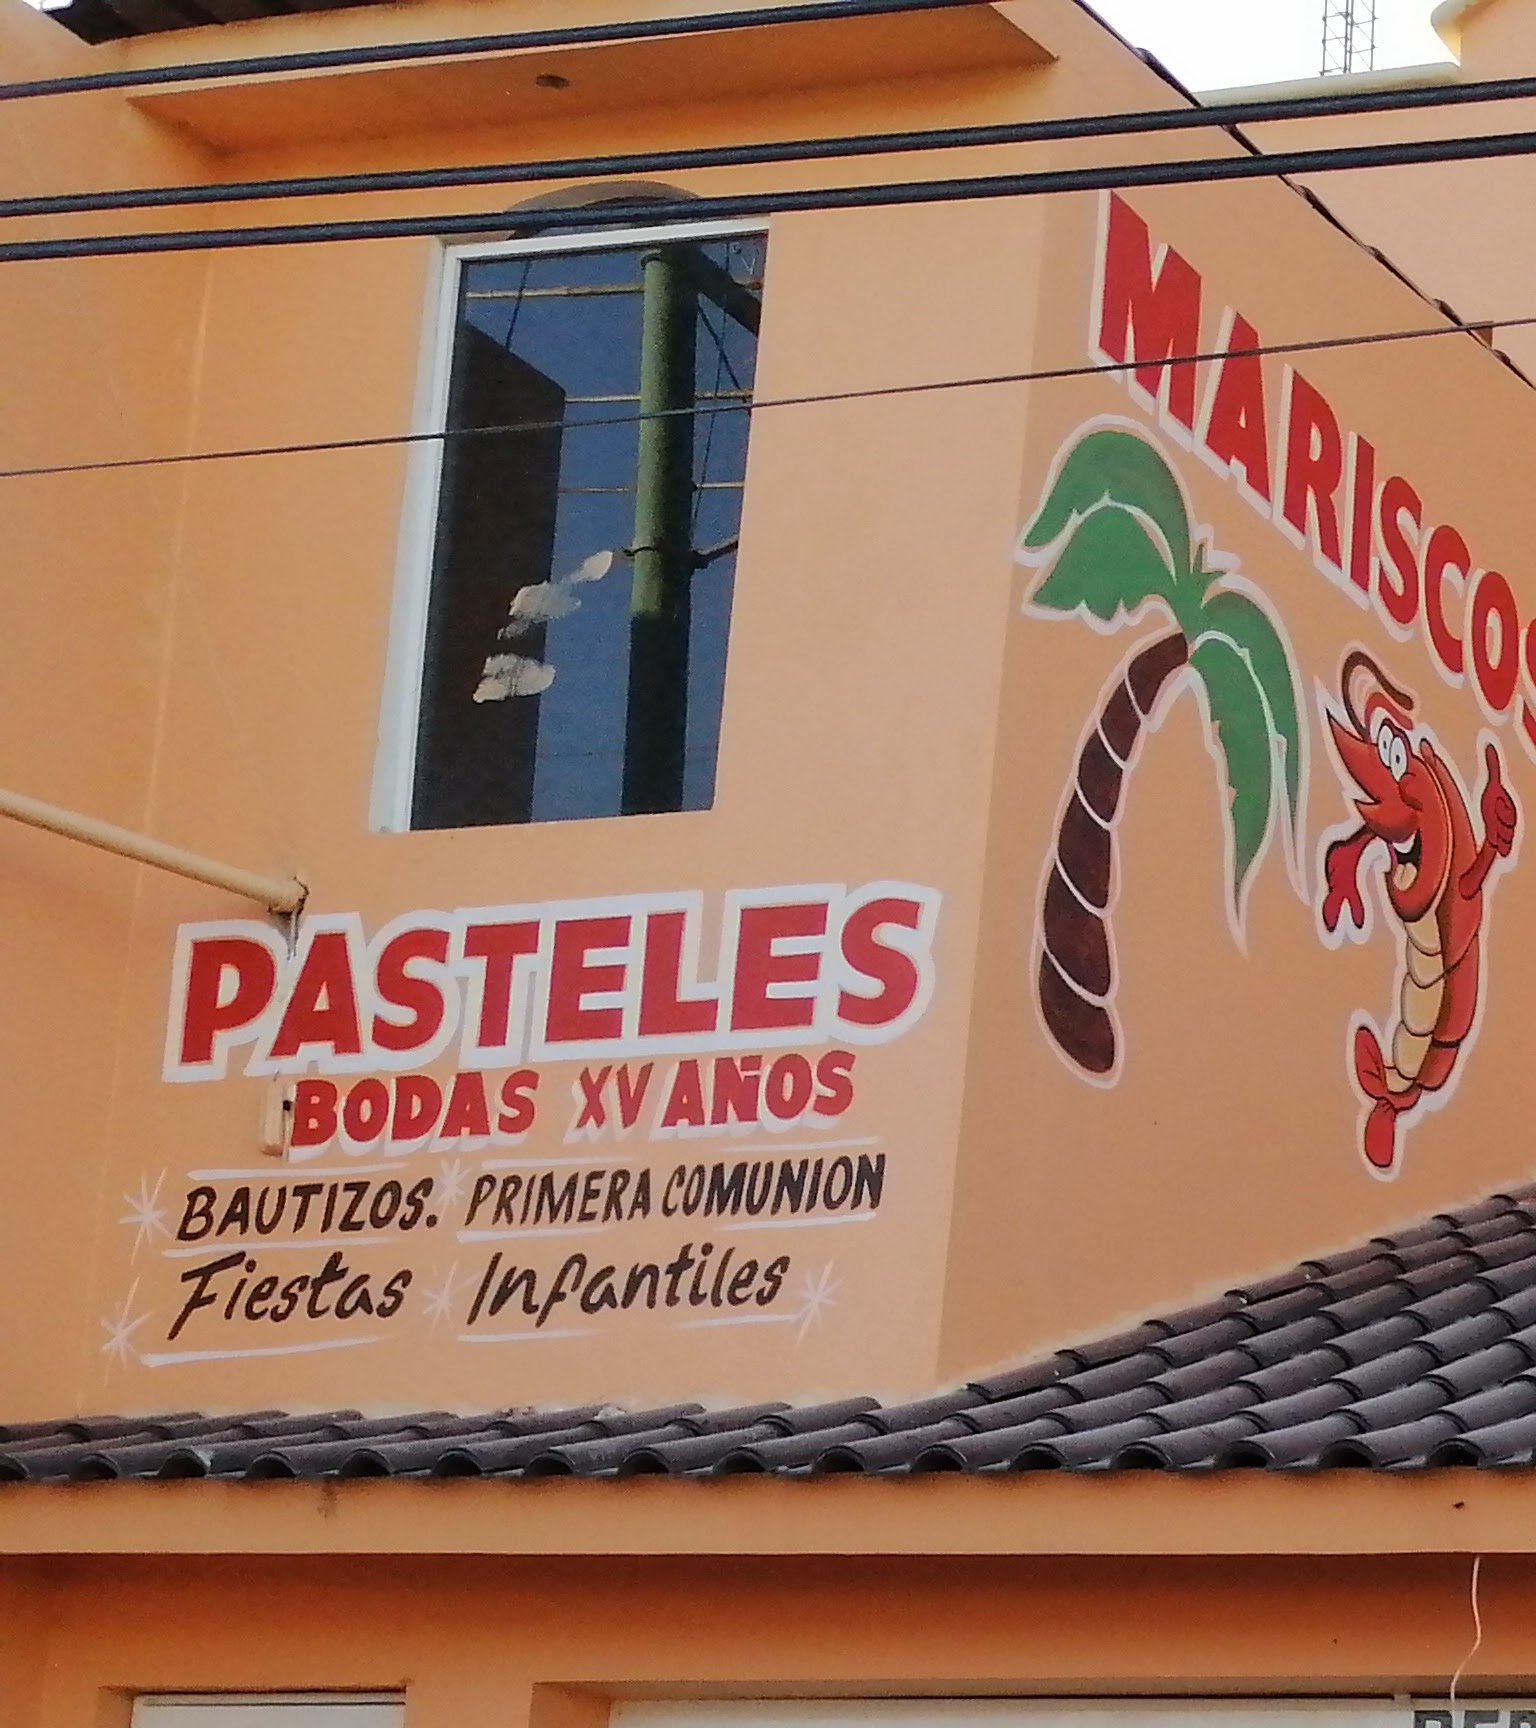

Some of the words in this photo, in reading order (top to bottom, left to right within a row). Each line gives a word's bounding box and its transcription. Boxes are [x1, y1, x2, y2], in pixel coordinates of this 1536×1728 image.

[180, 896, 922, 1066] PASTELES
[289, 1070, 540, 1146] BODAS
[576, 1062, 655, 1129] XV
[175, 1178, 440, 1242] BAUTIZOS.
[464, 1168, 651, 1228] PRIMERA
[661, 1152, 887, 1216] COMUNION
[167, 1250, 413, 1341] Fiestas
[466, 1242, 792, 1329] Infantiles
